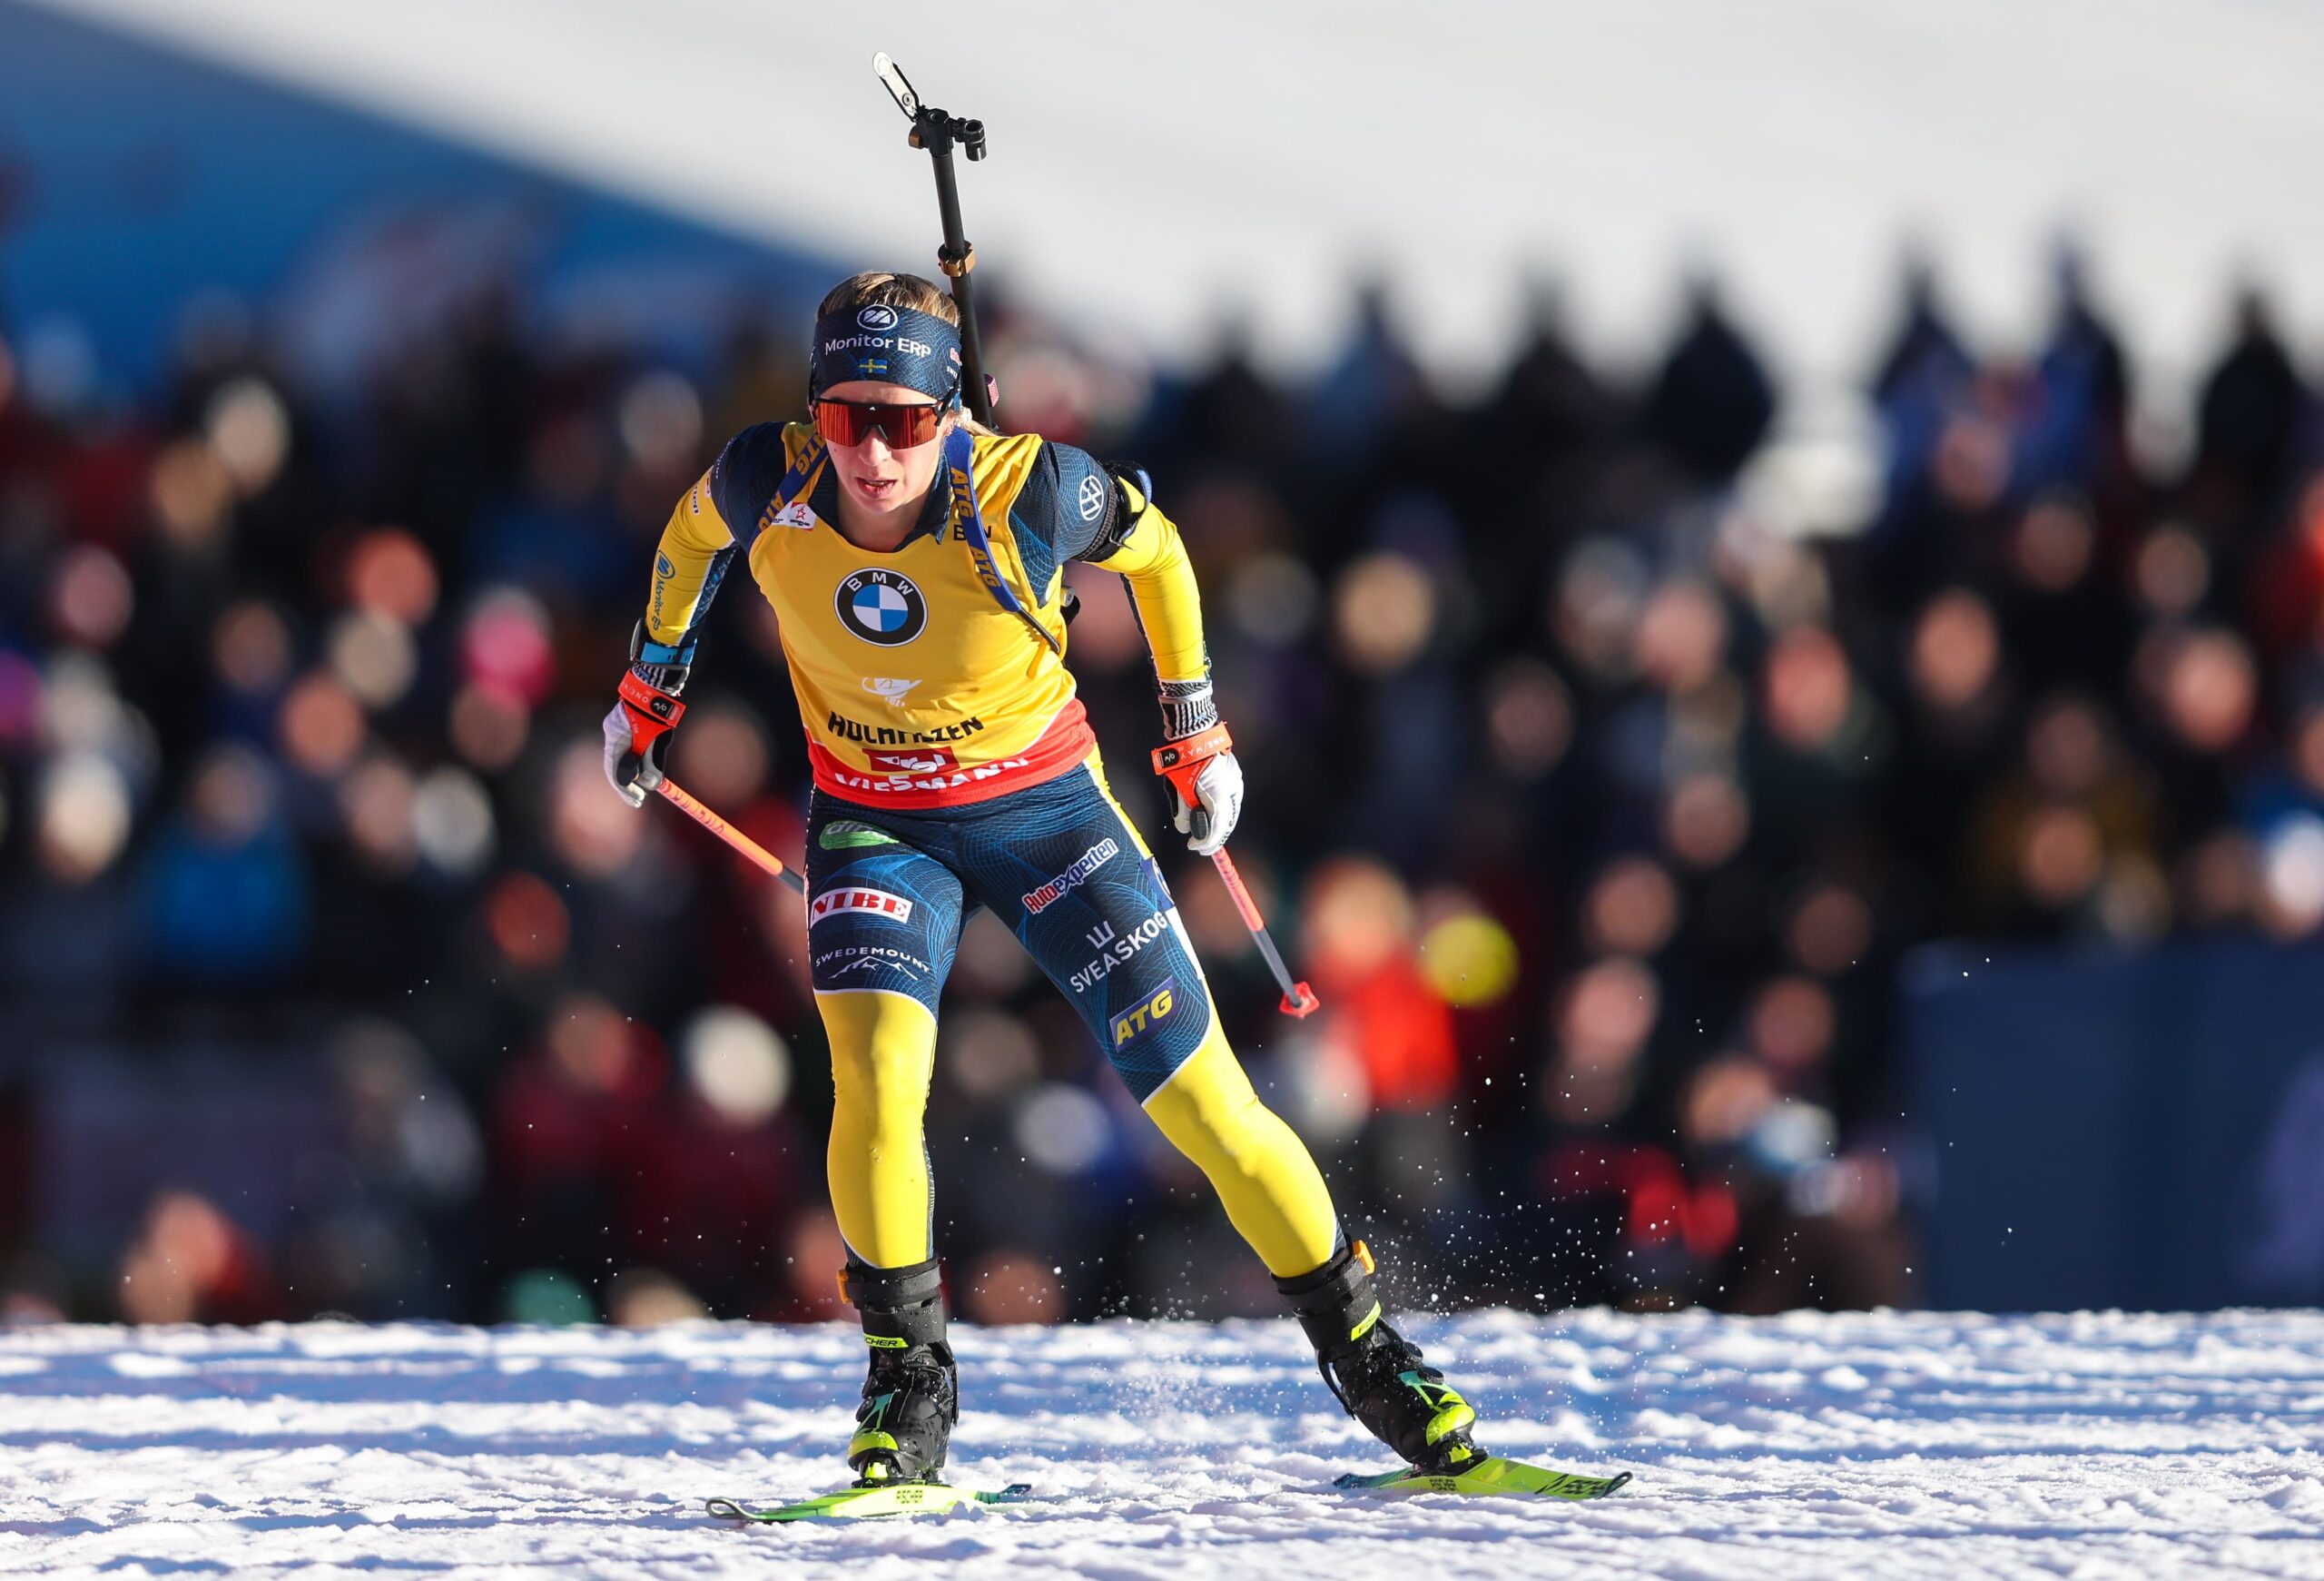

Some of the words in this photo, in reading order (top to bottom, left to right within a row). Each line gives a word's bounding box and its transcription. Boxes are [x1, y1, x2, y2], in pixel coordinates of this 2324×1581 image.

[825, 333, 894, 355] Monitor
[897, 337, 931, 359] ERP
[950, 467, 975, 519] ATG
[846, 571, 914, 596] BMW
[970, 545, 1001, 588] ATG
[1022, 838, 1118, 914] Autoexperten
[812, 892, 907, 921] NIBE
[815, 946, 931, 973] SWEDEMOUNT
[1070, 910, 1167, 993] SVEASKOG
[1117, 989, 1173, 1046] ATG
[865, 1337, 898, 1347] CHER
